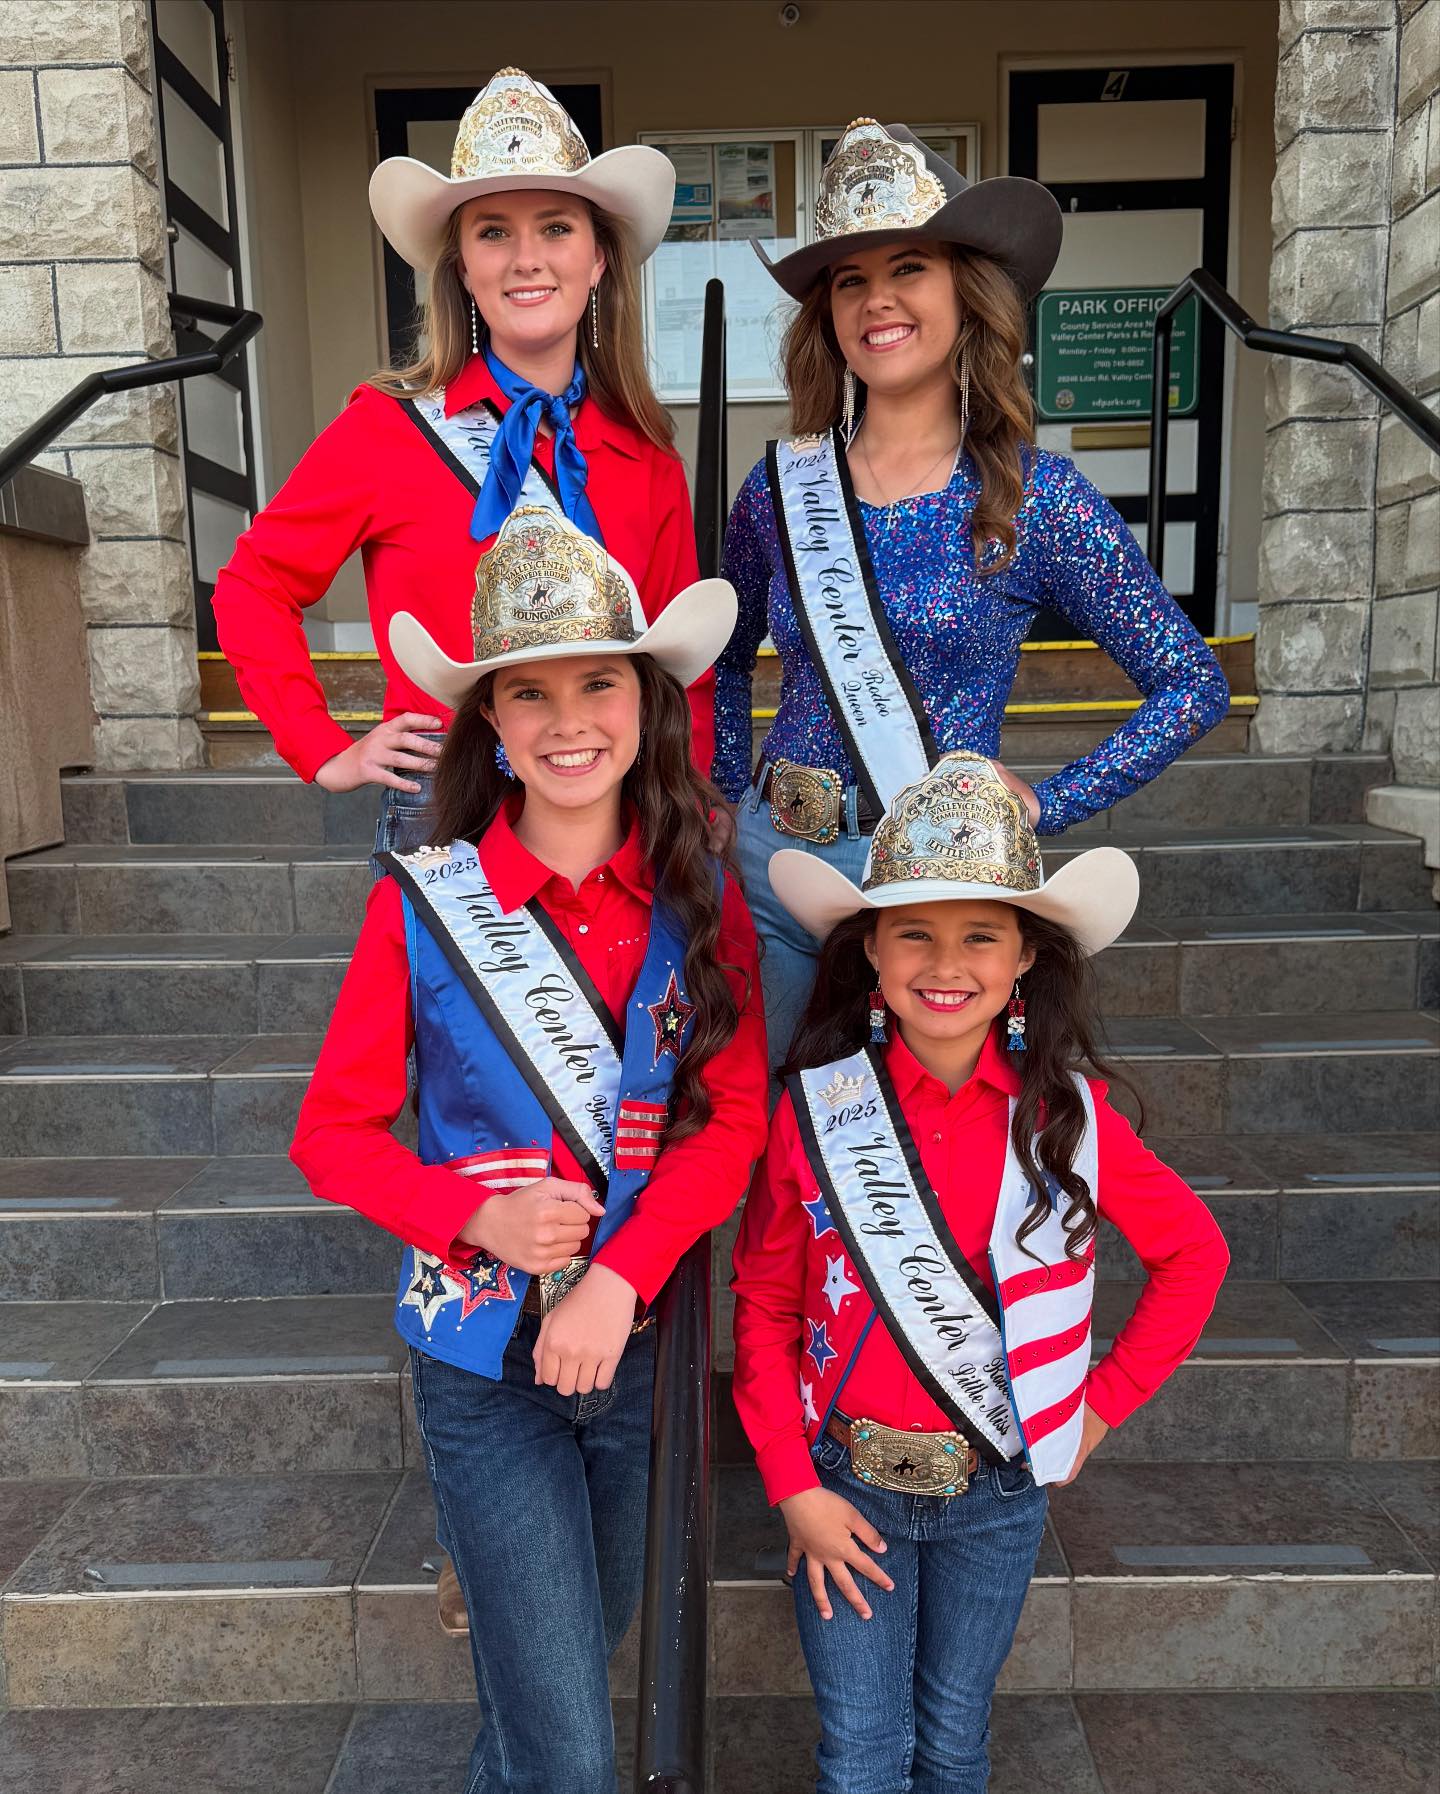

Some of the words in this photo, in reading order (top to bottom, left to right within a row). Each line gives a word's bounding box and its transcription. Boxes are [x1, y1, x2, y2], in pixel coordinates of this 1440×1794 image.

[1105, 73, 1126, 98] 4
[854, 203, 885, 217] QUEEN
[1058, 299, 1107, 315] PARK
[1113, 298, 1166, 313] OFFIC
[1051, 333, 1075, 342] Valley
[1077, 331, 1104, 341] Center
[1107, 330, 1131, 339] Parks
[1060, 322, 1090, 331] County
[1092, 321, 1122, 330] Service
[1124, 320, 1143, 329] Area
[1058, 347, 1087, 356] Monday
[1094, 346, 1117, 355] Friday
[505, 562, 533, 584] VALLEY
[535, 560, 570, 575] CENTER
[796, 469, 840, 555] Valley
[818, 557, 866, 664] Center
[508, 570, 543, 591] STAMPEDE
[544, 570, 570, 583] RODEO
[512, 608, 549, 621] YOUNG
[550, 599, 575, 619] MISS
[840, 680, 868, 727] Queen
[862, 668, 891, 718] Rodeo
[929, 802, 963, 816] VALLEY
[964, 802, 998, 821] CENTER
[931, 811, 969, 825] STAMPEDE
[971, 812, 995, 829] RODEO
[928, 839, 965, 859] LITTLE
[970, 844, 996, 859] MISS
[424, 857, 478, 886] 2025
[456, 881, 531, 973] Valley
[524, 973, 600, 1084] Center
[824, 1097, 878, 1135] 2025
[846, 1131, 911, 1239] Valley
[899, 1244, 973, 1351] Center
[948, 1362, 984, 1403] Little
[979, 1403, 1010, 1436] Miss
